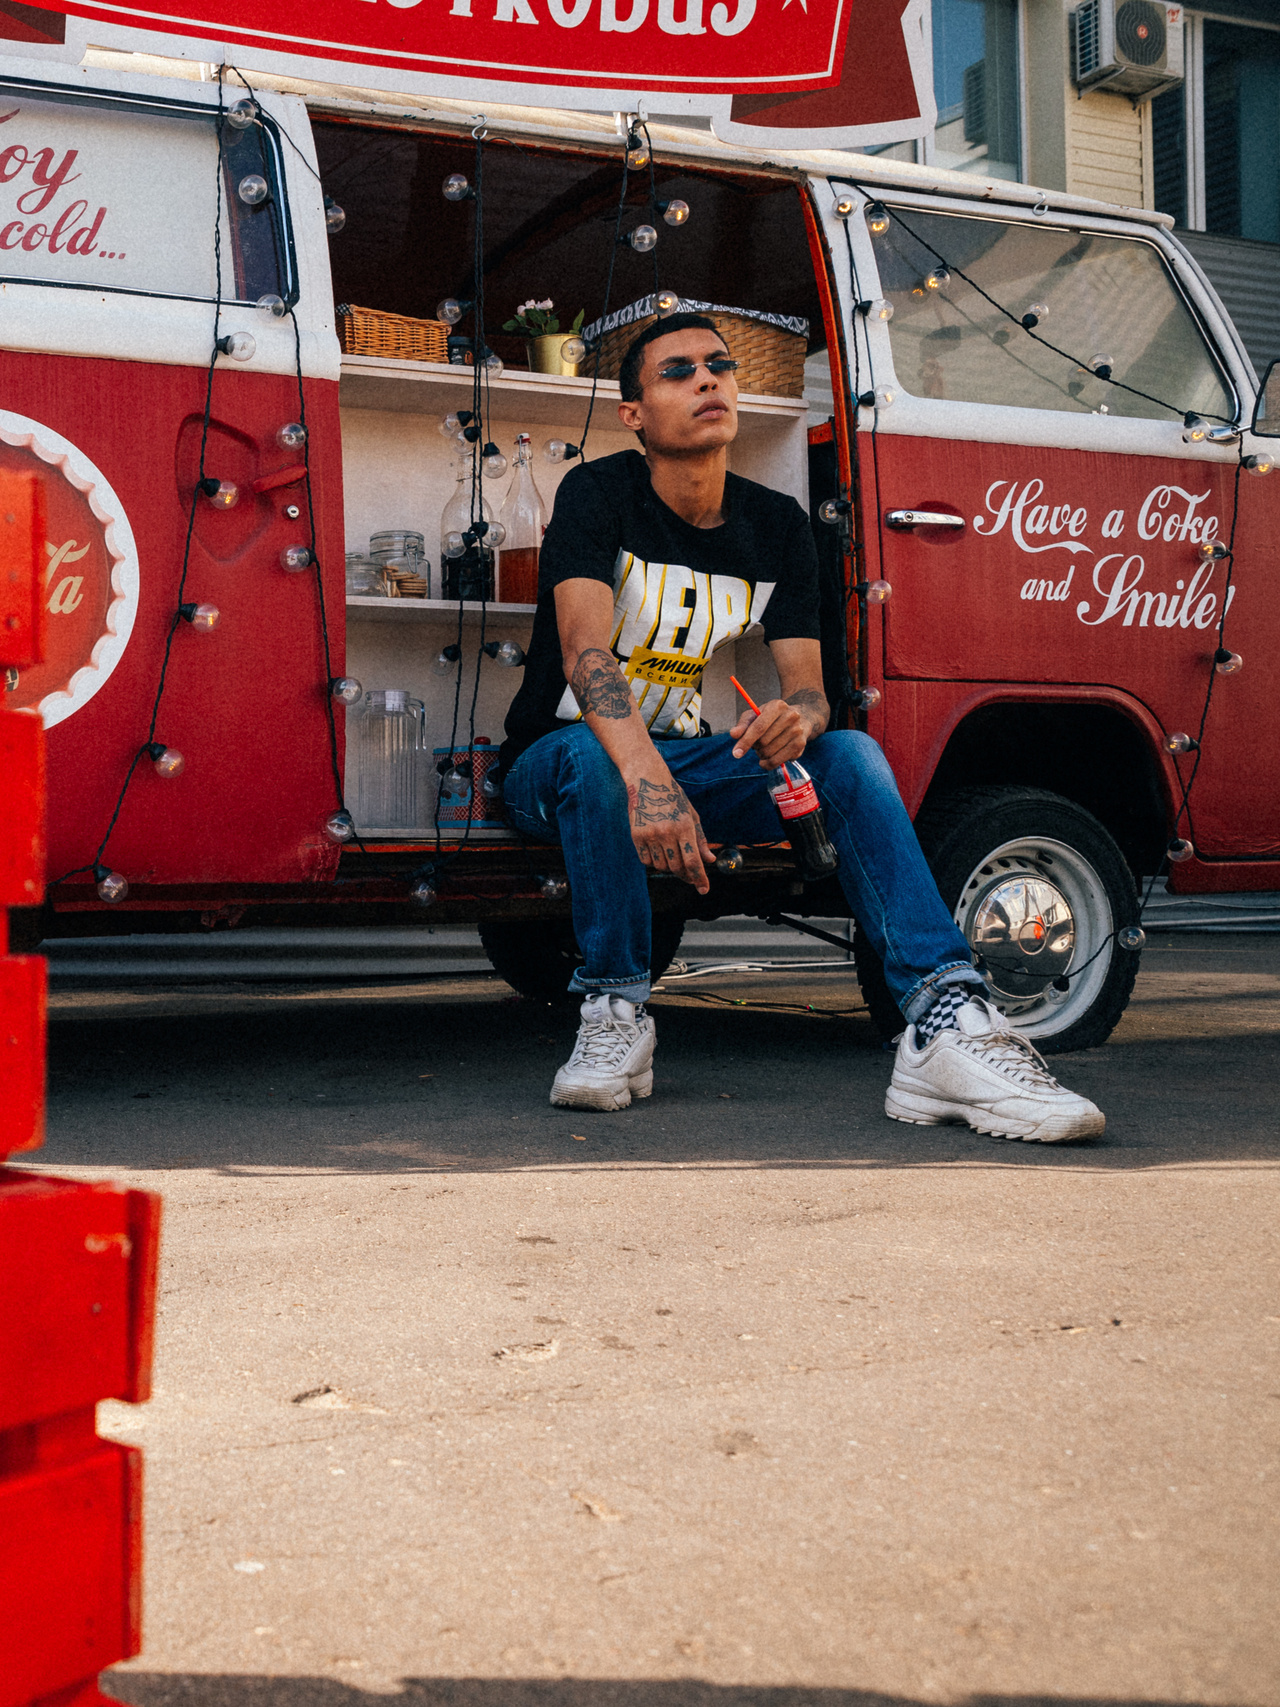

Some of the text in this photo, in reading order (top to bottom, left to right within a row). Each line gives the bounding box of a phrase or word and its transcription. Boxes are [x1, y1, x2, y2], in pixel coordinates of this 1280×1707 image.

[973, 478, 1219, 554] Have a Coke
[1020, 565, 1076, 601] and
